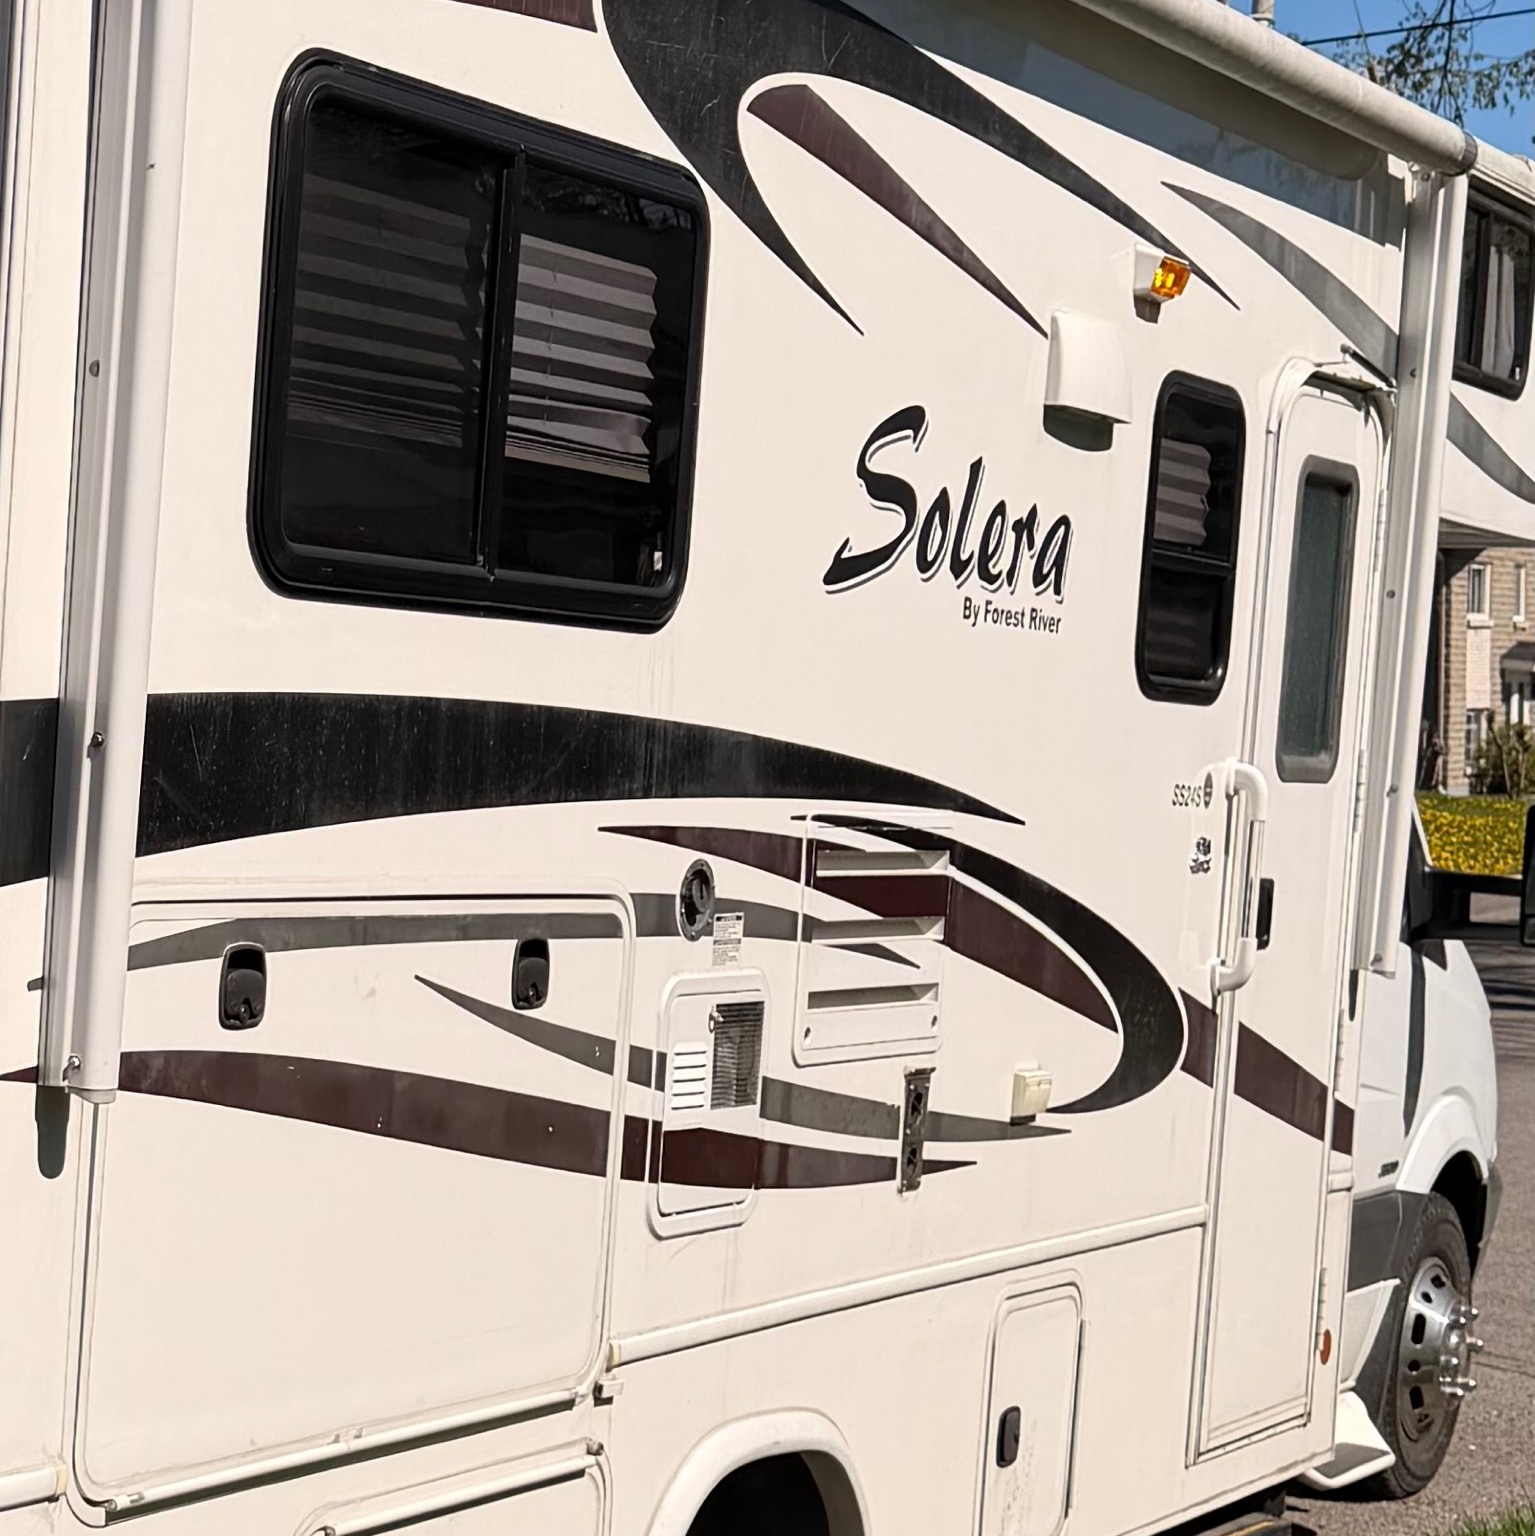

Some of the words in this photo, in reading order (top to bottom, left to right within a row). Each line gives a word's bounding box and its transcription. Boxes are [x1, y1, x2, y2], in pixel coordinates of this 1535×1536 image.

[822, 404, 1074, 604] Solera
[963, 596, 981, 628] By
[984, 599, 1026, 630] Forest
[1028, 607, 1062, 635] River
